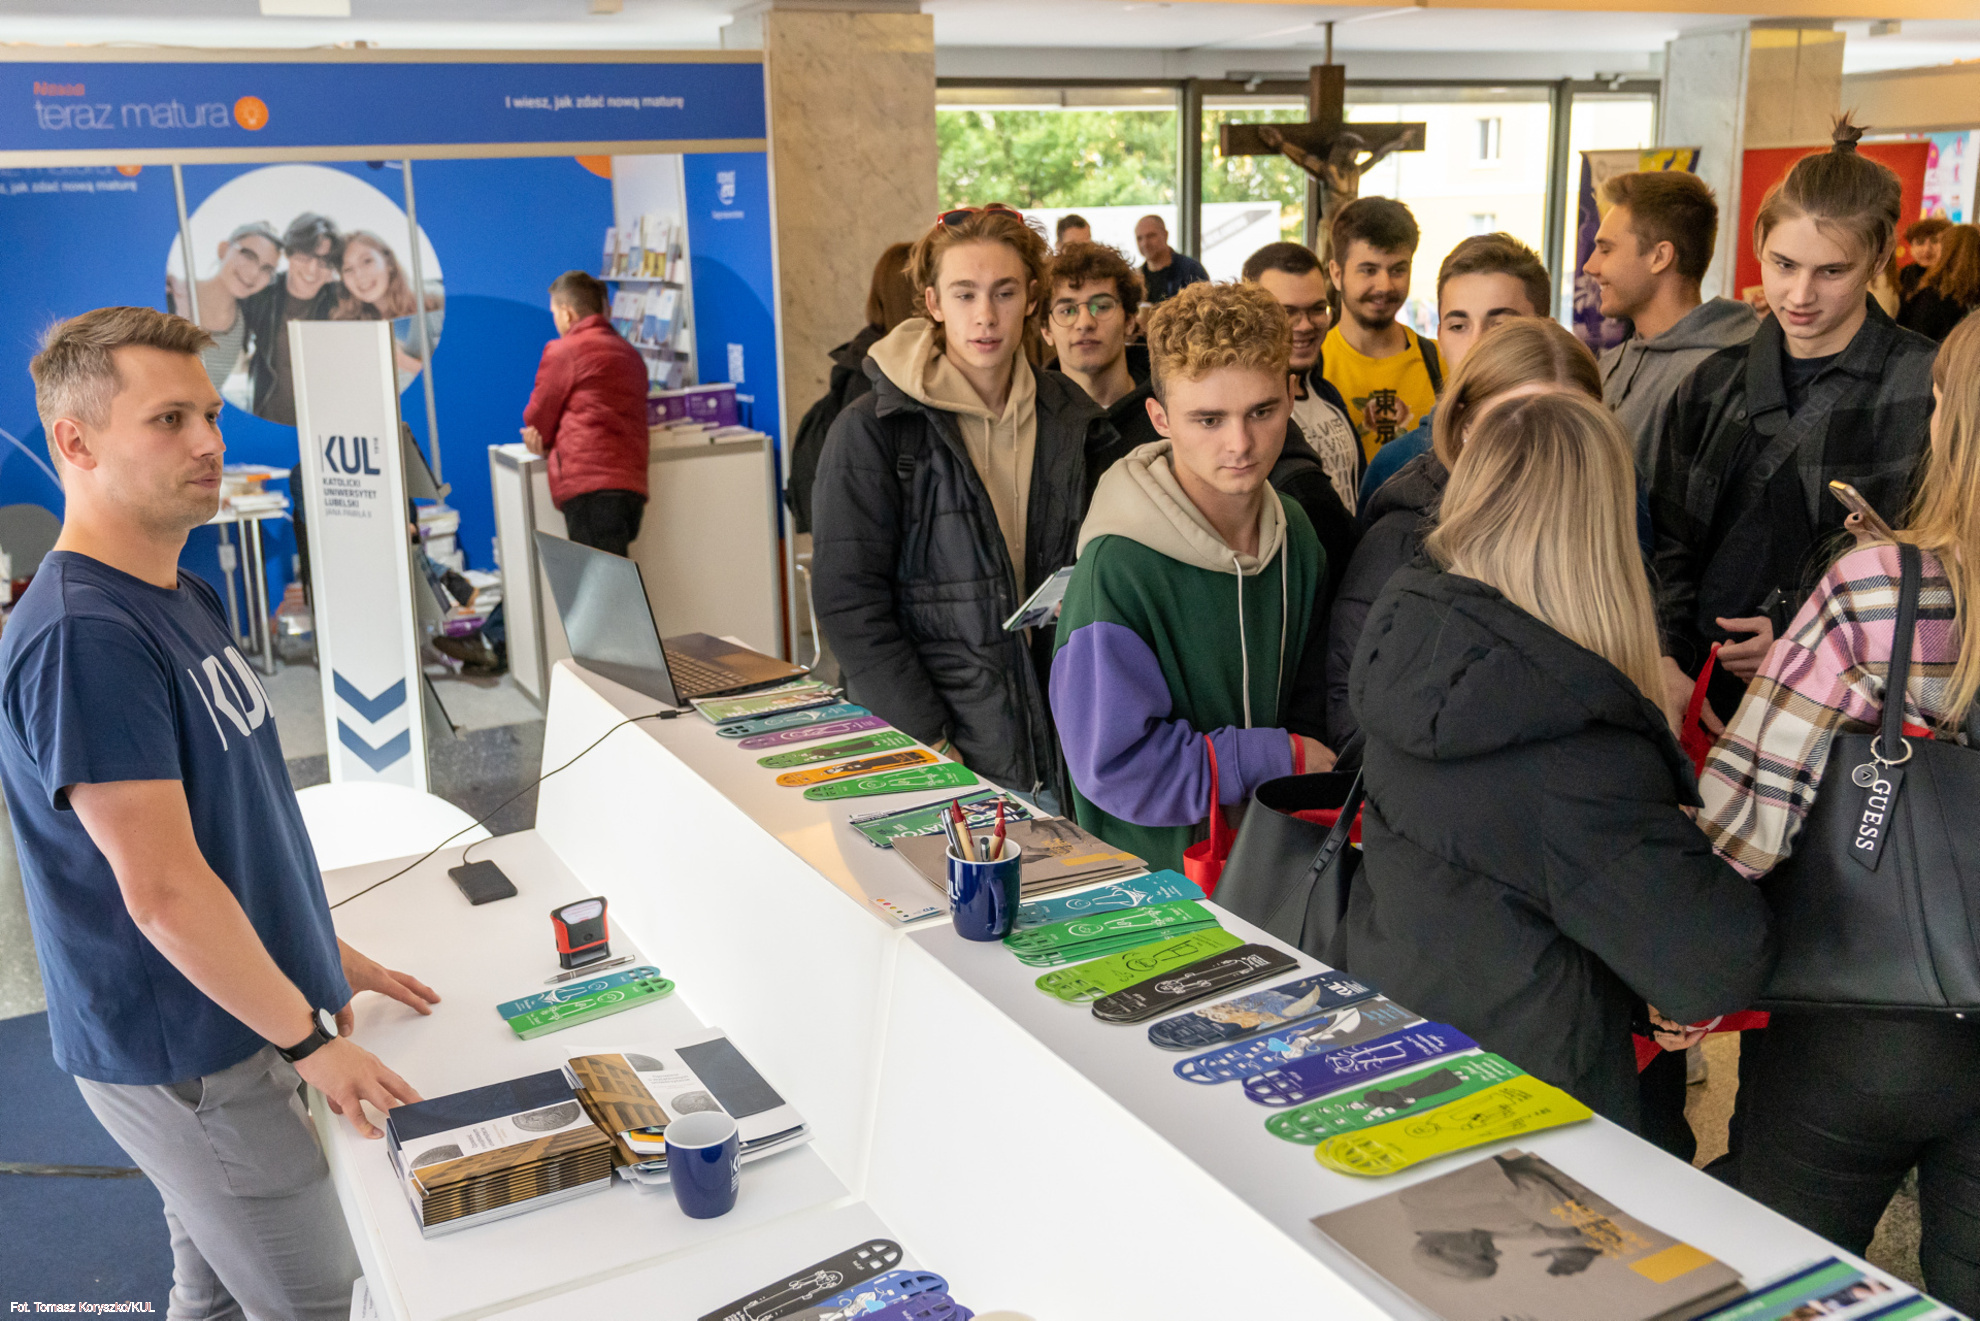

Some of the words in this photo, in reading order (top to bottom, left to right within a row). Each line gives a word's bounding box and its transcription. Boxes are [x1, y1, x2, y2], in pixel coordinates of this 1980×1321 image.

[35, 100, 115, 130] teraz
[120, 99, 231, 129] matura
[554, 94, 572, 111] jak
[576, 94, 605, 108] zdać
[1373, 388, 1398, 444] 東京
[325, 435, 381, 475] KUL
[323, 477, 361, 487] KATOLICKI
[323, 488, 377, 499] UNIWERSYTET
[324, 498, 360, 508] LUBELSKI
[1854, 779, 1892, 851] GUESS
